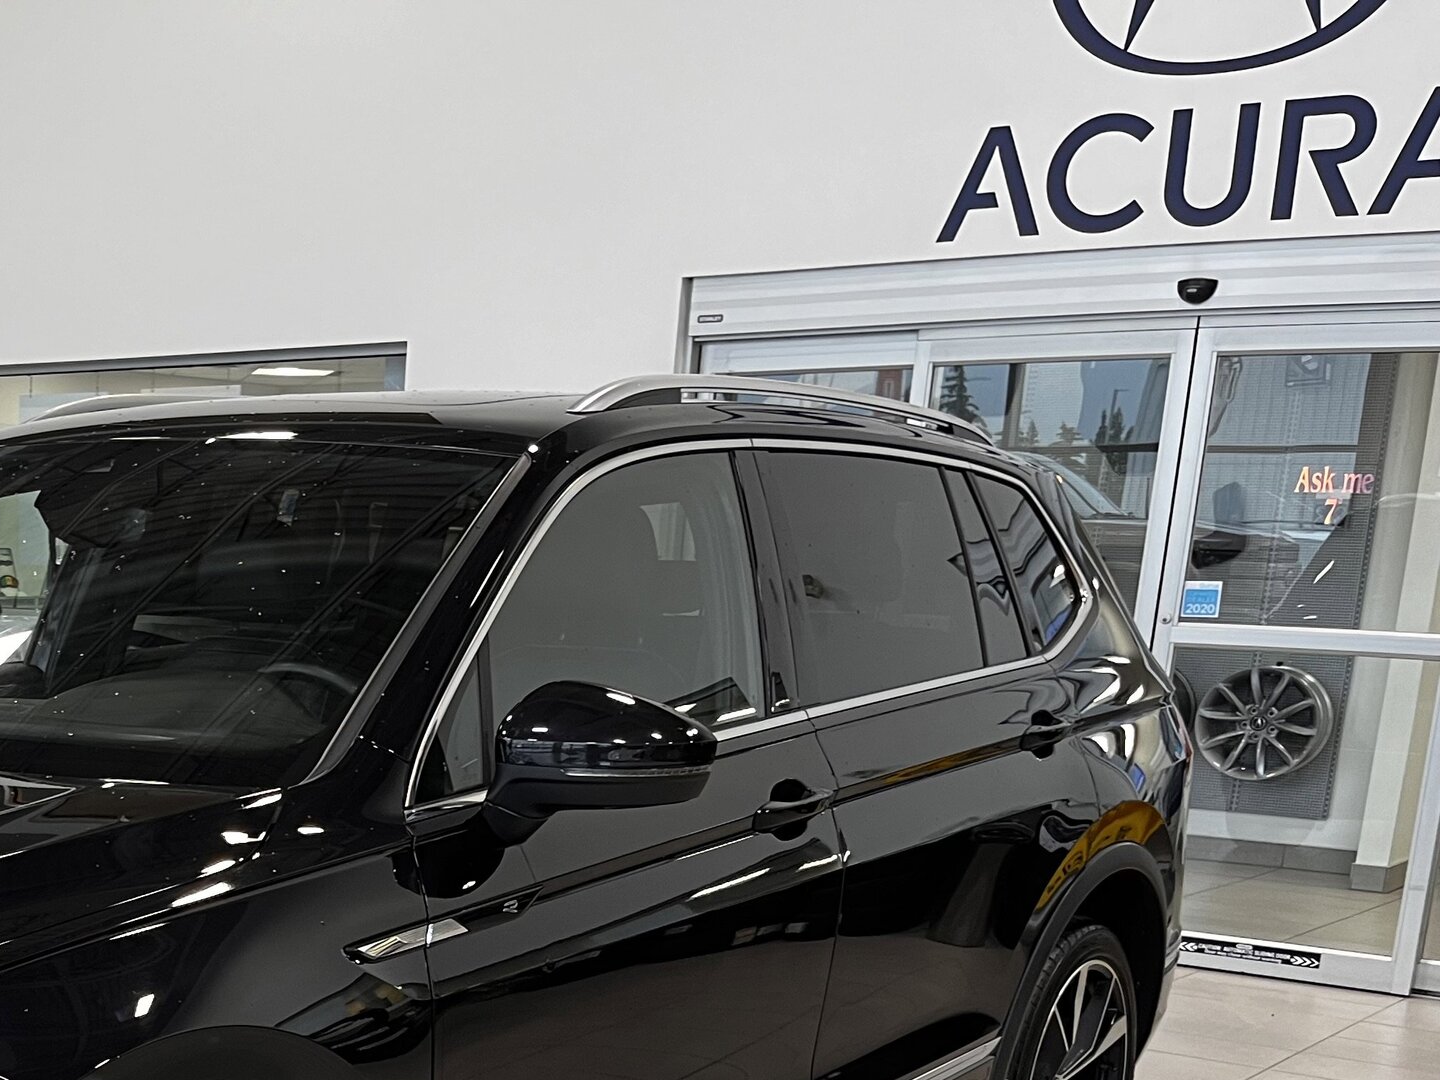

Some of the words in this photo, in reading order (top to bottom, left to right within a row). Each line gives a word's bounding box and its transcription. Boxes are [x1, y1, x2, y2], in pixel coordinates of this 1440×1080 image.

[936, 86, 1440, 243] ACURA
[1294, 466, 1336, 493] Ask
[1341, 472, 1375, 494] me
[1185, 603, 1216, 614] 2020
